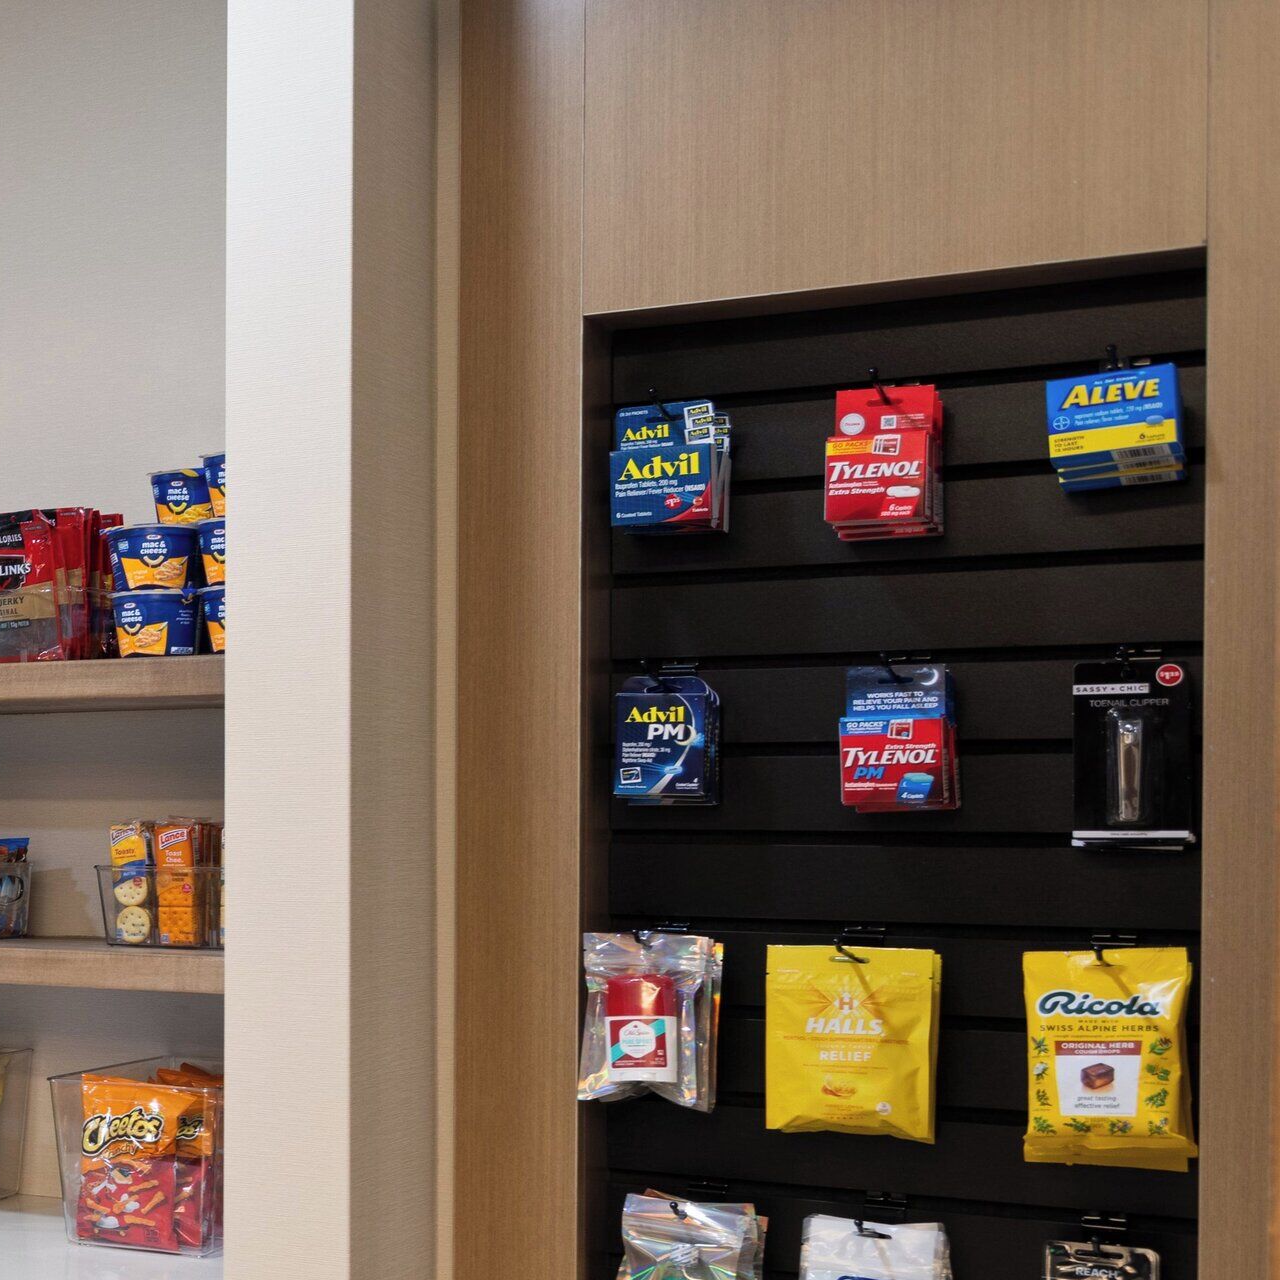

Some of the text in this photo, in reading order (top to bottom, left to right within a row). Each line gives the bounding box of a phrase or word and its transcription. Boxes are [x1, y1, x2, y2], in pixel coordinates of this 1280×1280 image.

[1060, 378, 1160, 409] ALEVE
[690, 407, 707, 415] Advil
[621, 424, 670, 441] Advil
[618, 452, 700, 481] Advil
[829, 461, 921, 482] TYLENOL
[615, 490, 626, 498] Pain
[850, 487, 885, 495] Strength
[0, 562, 32, 577] LINK'S
[1089, 698, 1169, 707] TOENAIL CLIPPER
[624, 706, 686, 723] Advil
[647, 724, 685, 740] PM
[843, 747, 937, 768] TYLENOL
[853, 766, 885, 780] PM
[901, 791, 907, 799] 4
[160, 829, 186, 845] Lance
[1039, 991, 1160, 1016] Ricola
[805, 1017, 884, 1035] HALLS
[1061, 1042, 1107, 1050] ORIGINAL
[819, 1051, 872, 1062] RELIEF
[1095, 1095, 1116, 1103] tasting
[82, 1109, 161, 1152] Cheetos
[1075, 1266, 1119, 1279] REACH
